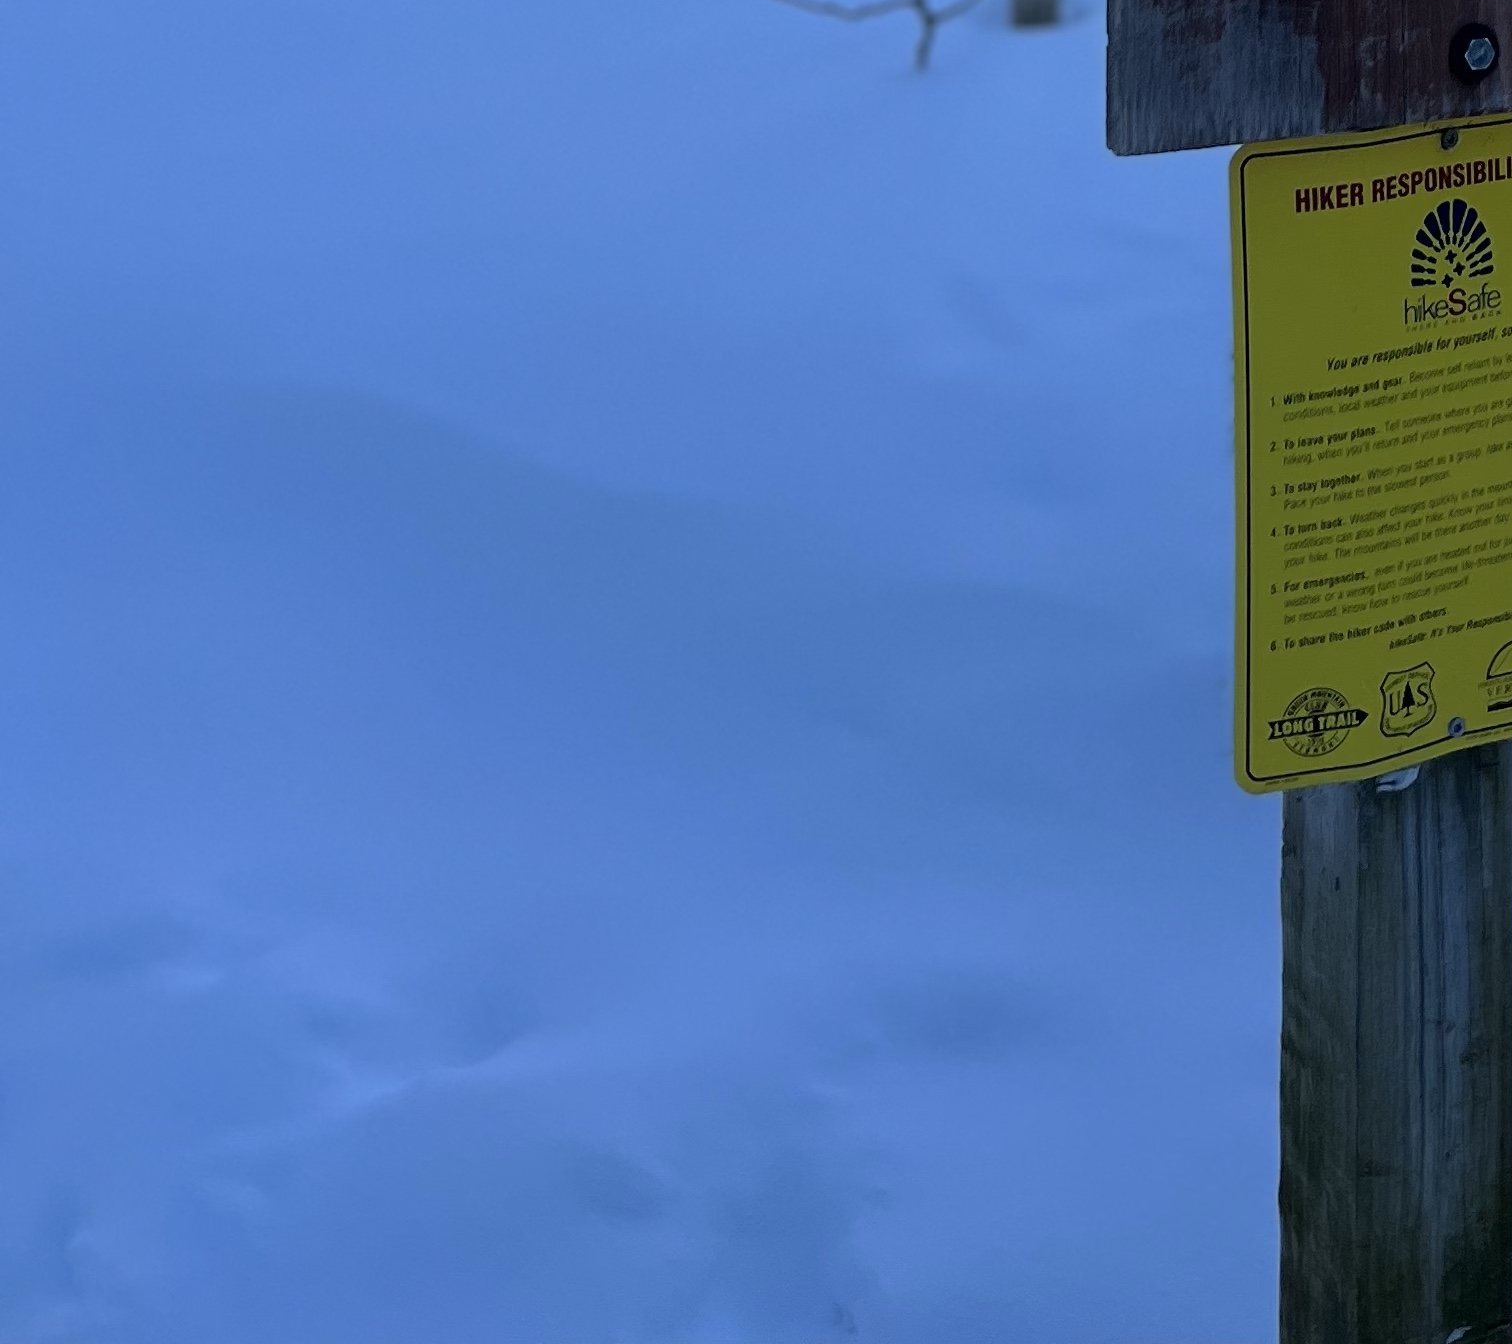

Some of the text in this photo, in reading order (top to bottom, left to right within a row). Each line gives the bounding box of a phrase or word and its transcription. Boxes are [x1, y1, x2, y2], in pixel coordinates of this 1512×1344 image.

[1294, 182, 1364, 213] HIKER
[1403, 283, 1501, 323] hikeSafe
[1327, 356, 1347, 371] You
[1350, 354, 1369, 367] are
[1372, 340, 1432, 362] responsible
[1435, 336, 1450, 350] for
[1500, 326, 1512, 338] so
[1283, 392, 1305, 405] With
[1308, 385, 1359, 400] knowledge
[1362, 379, 1379, 392] and
[1283, 438, 1295, 450] To
[1297, 435, 1324, 447] leave
[1326, 431, 1348, 445] your
[1283, 483, 1294, 494] To
[1297, 481, 1317, 492] stay
[1283, 524, 1294, 536] To
[1297, 522, 1317, 534] turn
[1283, 580, 1300, 592] For
[1284, 636, 1295, 649] To
[1298, 634, 1326, 647] share
[1328, 631, 1344, 642] the
[1346, 626, 1371, 639] hiker
[1274, 710, 1360, 736] LONG TRAIL
